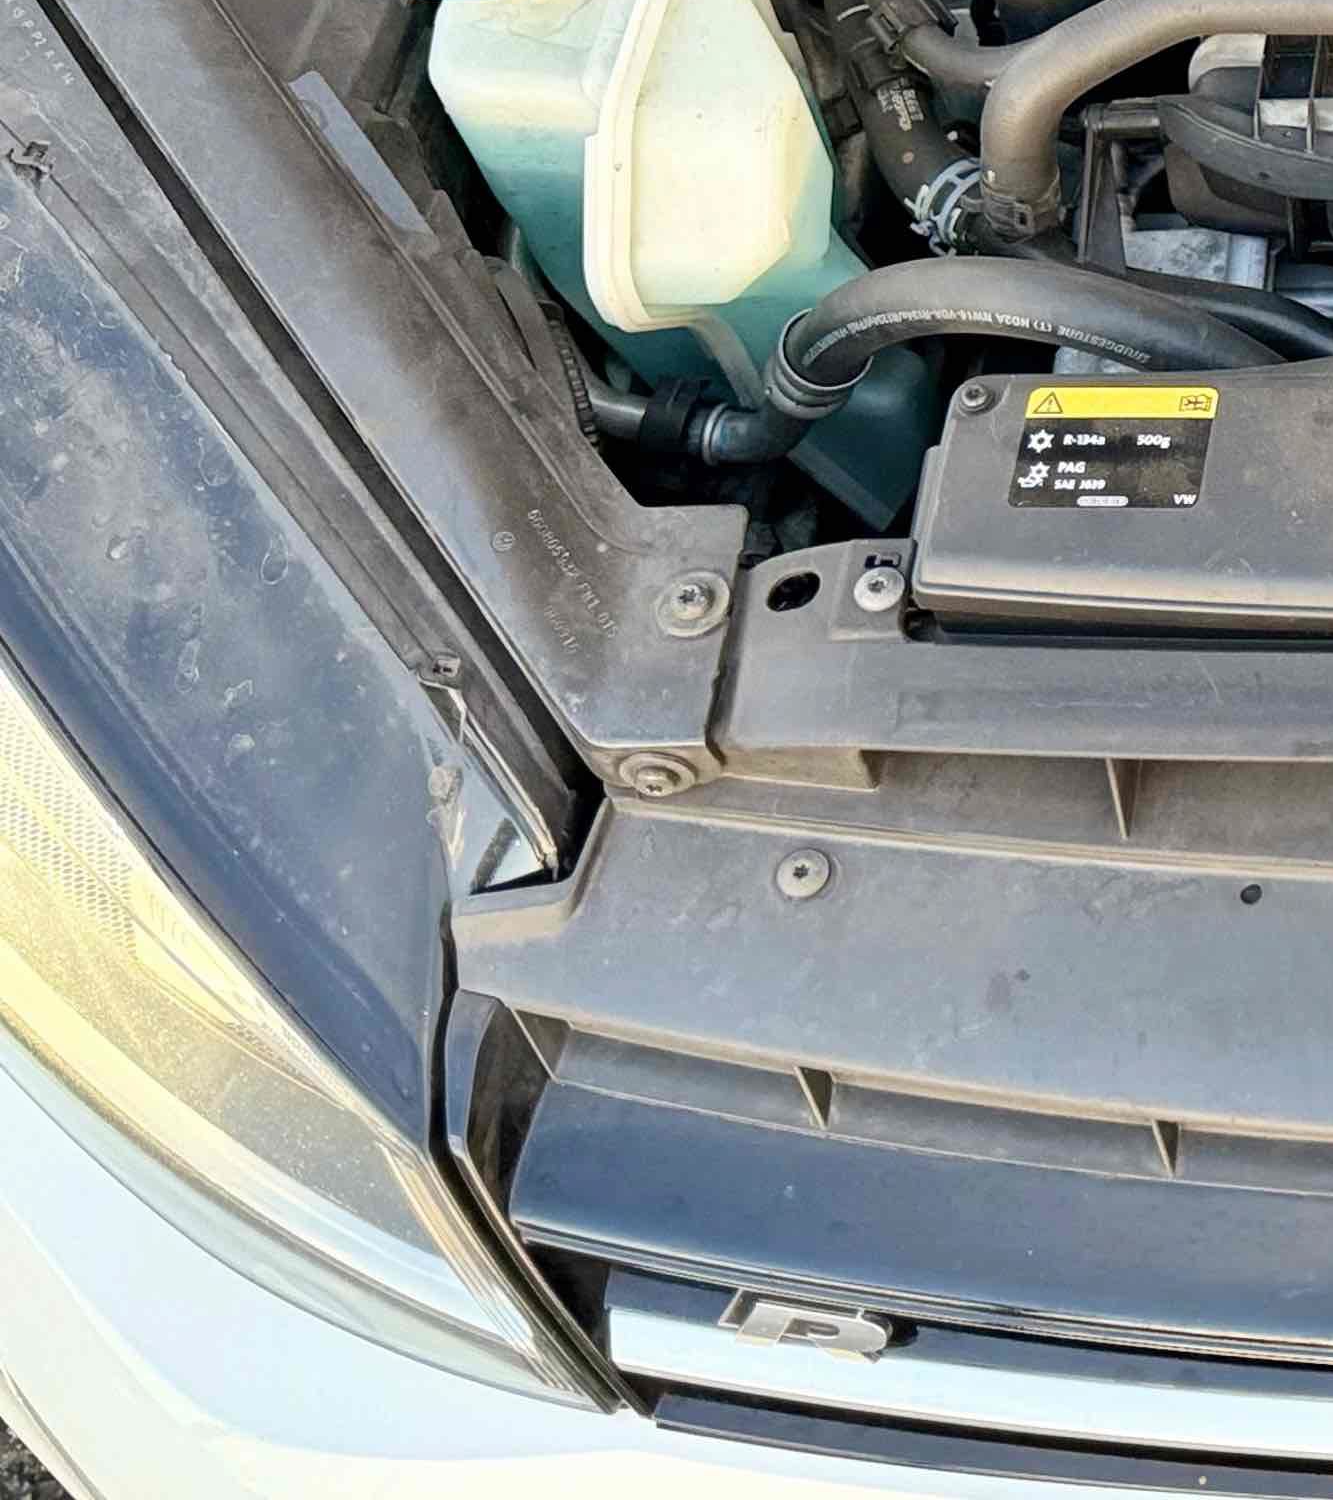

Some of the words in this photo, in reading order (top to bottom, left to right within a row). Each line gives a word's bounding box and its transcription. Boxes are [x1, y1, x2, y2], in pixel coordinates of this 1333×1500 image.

[1062, 433, 1107, 447] R-134a
[1136, 433, 1172, 450] 500g
[1057, 460, 1086, 474] PAG
[1054, 478, 1076, 491] SAE
[1172, 493, 1197, 506] VW
